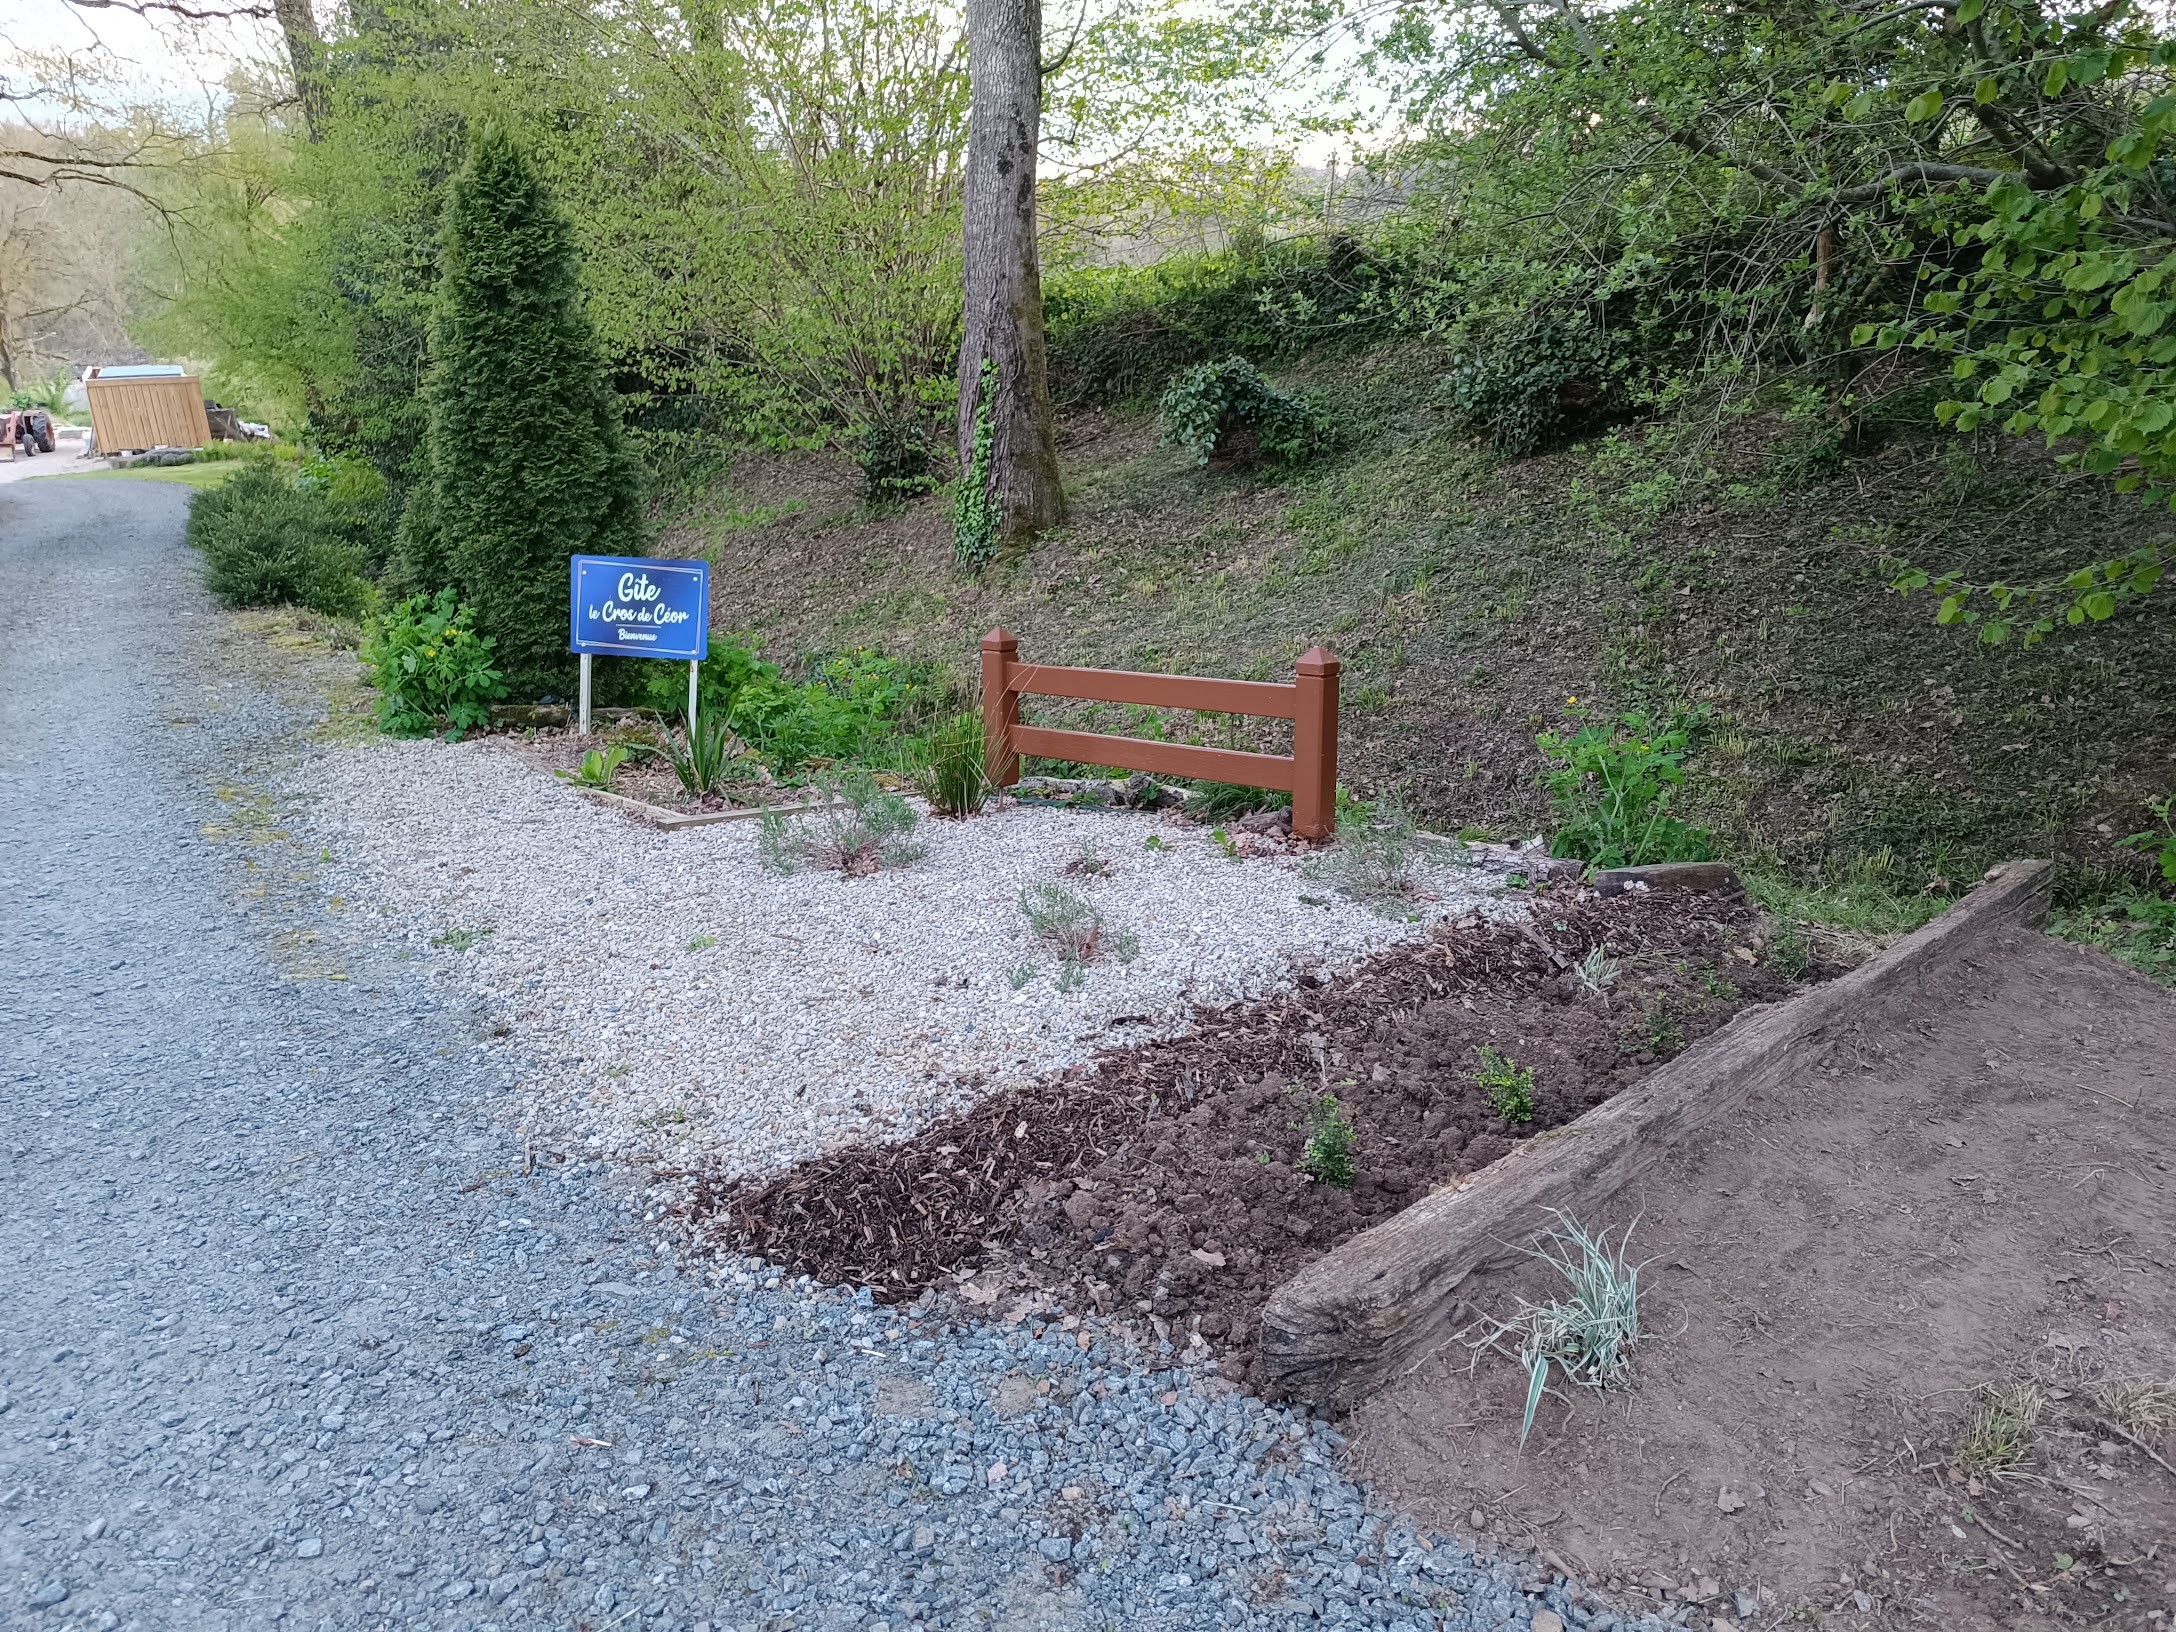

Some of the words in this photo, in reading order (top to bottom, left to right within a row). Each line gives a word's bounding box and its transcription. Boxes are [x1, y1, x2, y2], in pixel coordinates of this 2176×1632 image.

[617, 572, 661, 602] Gîte
[588, 604, 601, 620] le
[602, 600, 637, 622] Cros
[637, 607, 653, 622] de
[653, 602, 689, 625] Céor
[617, 628, 658, 641] Bienvenue
